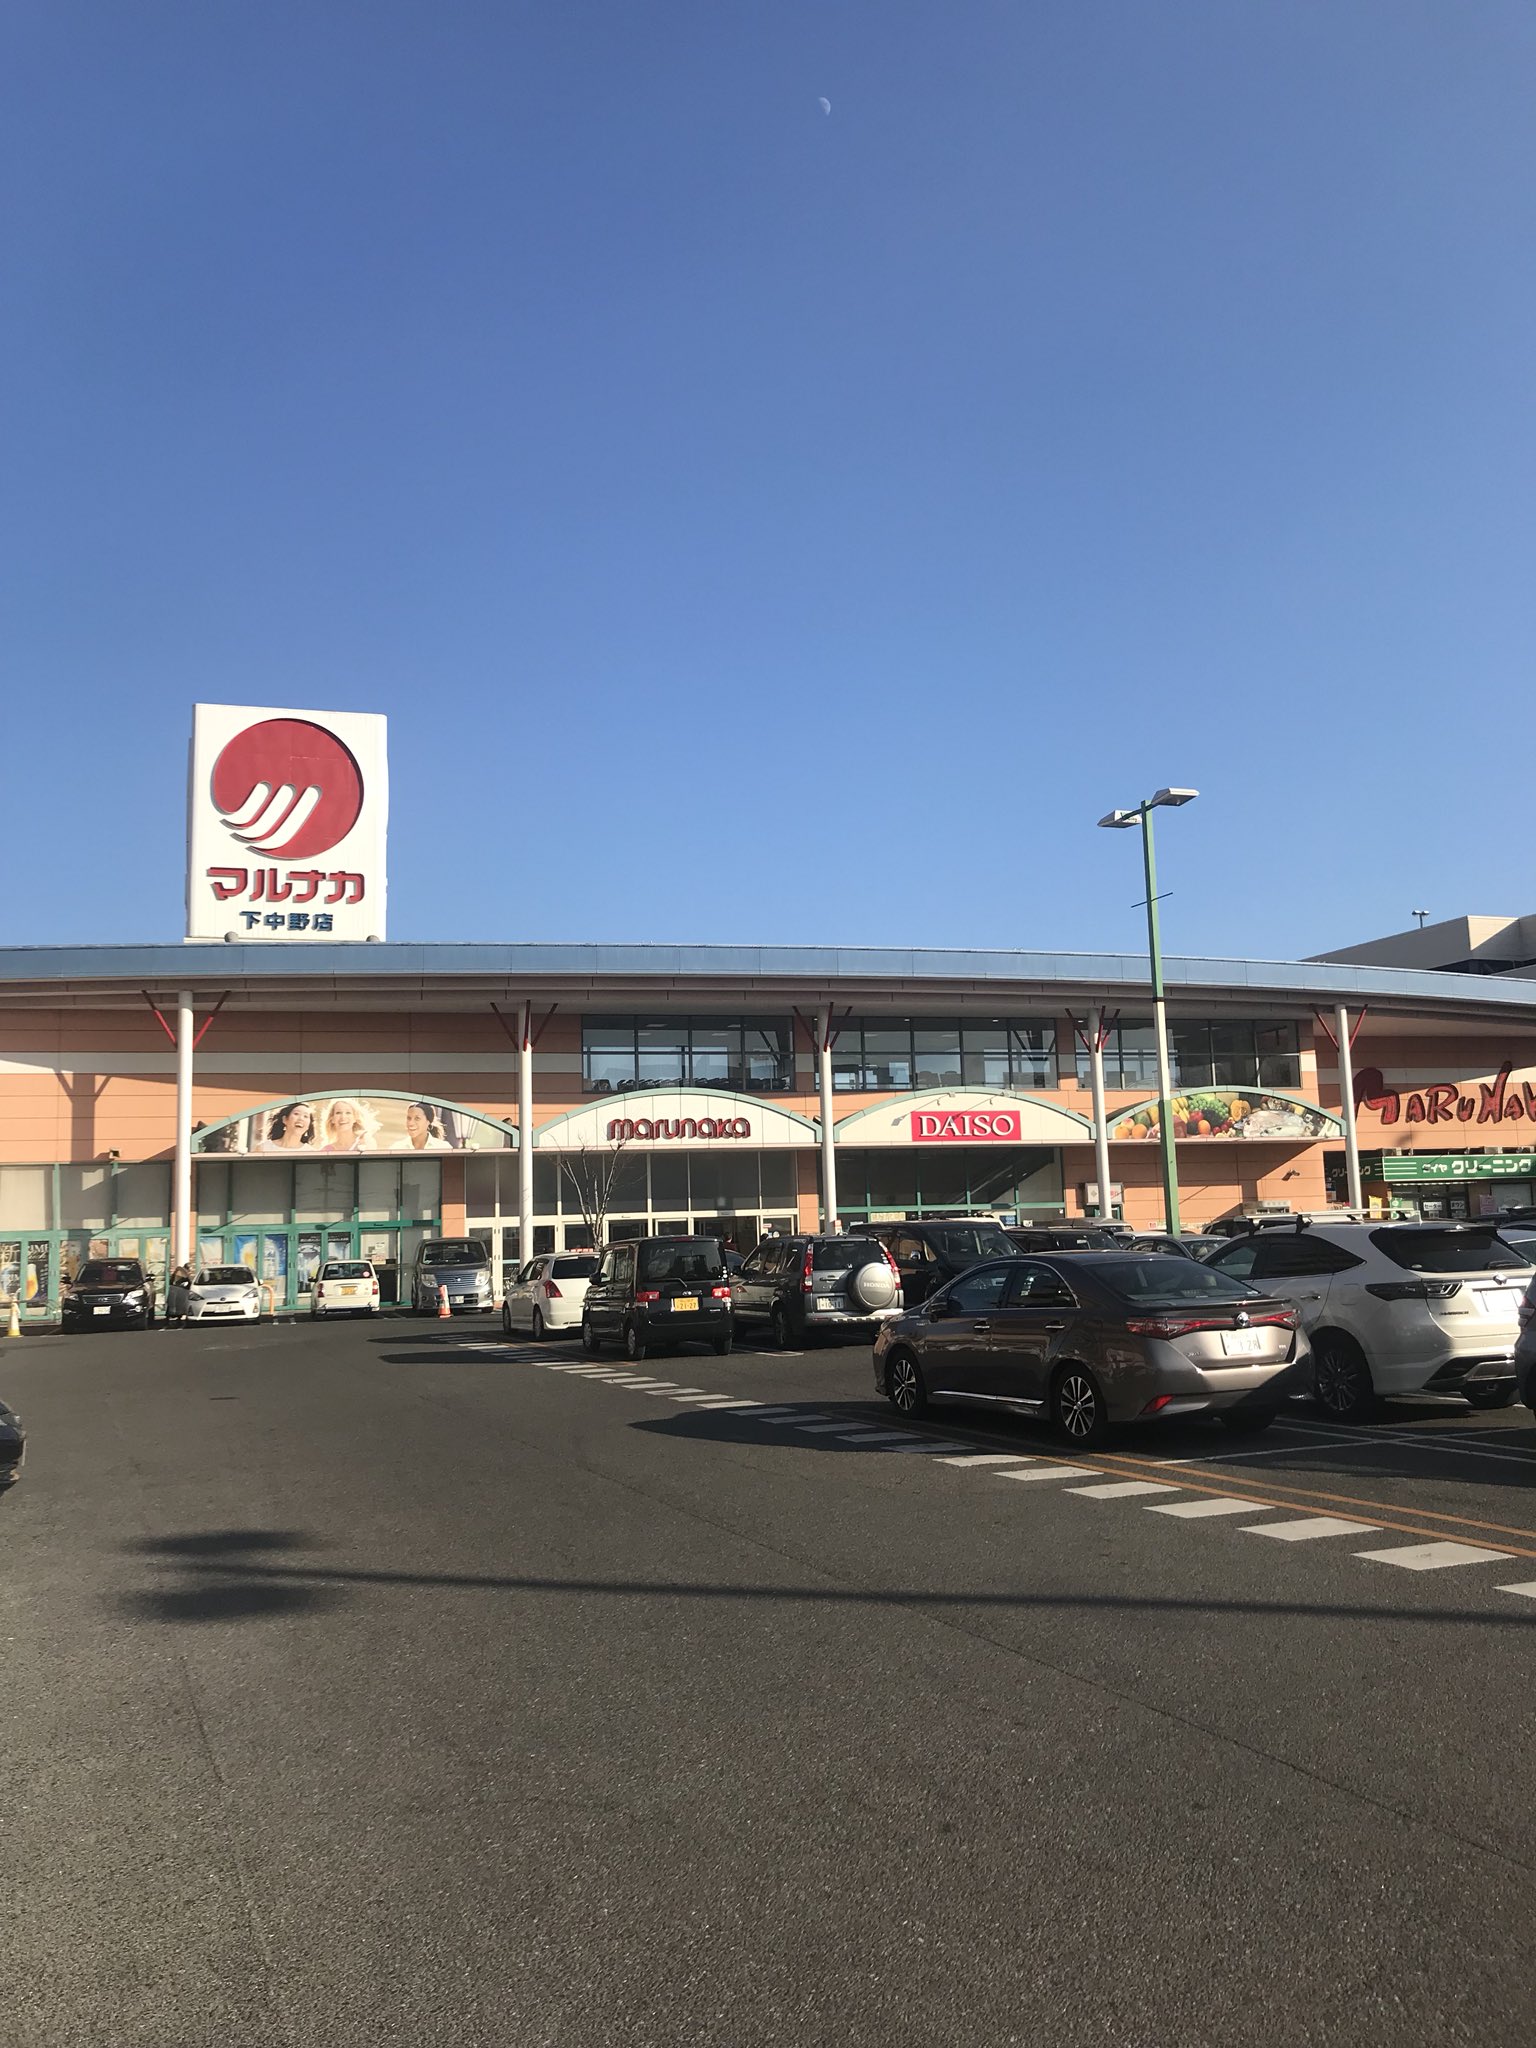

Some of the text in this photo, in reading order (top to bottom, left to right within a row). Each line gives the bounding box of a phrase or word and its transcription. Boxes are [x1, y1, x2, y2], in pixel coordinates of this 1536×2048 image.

[206, 866, 365, 905] マルナカ
[239, 910, 334, 932] 下中野店
[606, 1117, 751, 1141] marunaka
[918, 1114, 1015, 1138] DAISO
[863, 1281, 891, 1289] HONDA
[679, 1302, 697, 1310] 21-27
